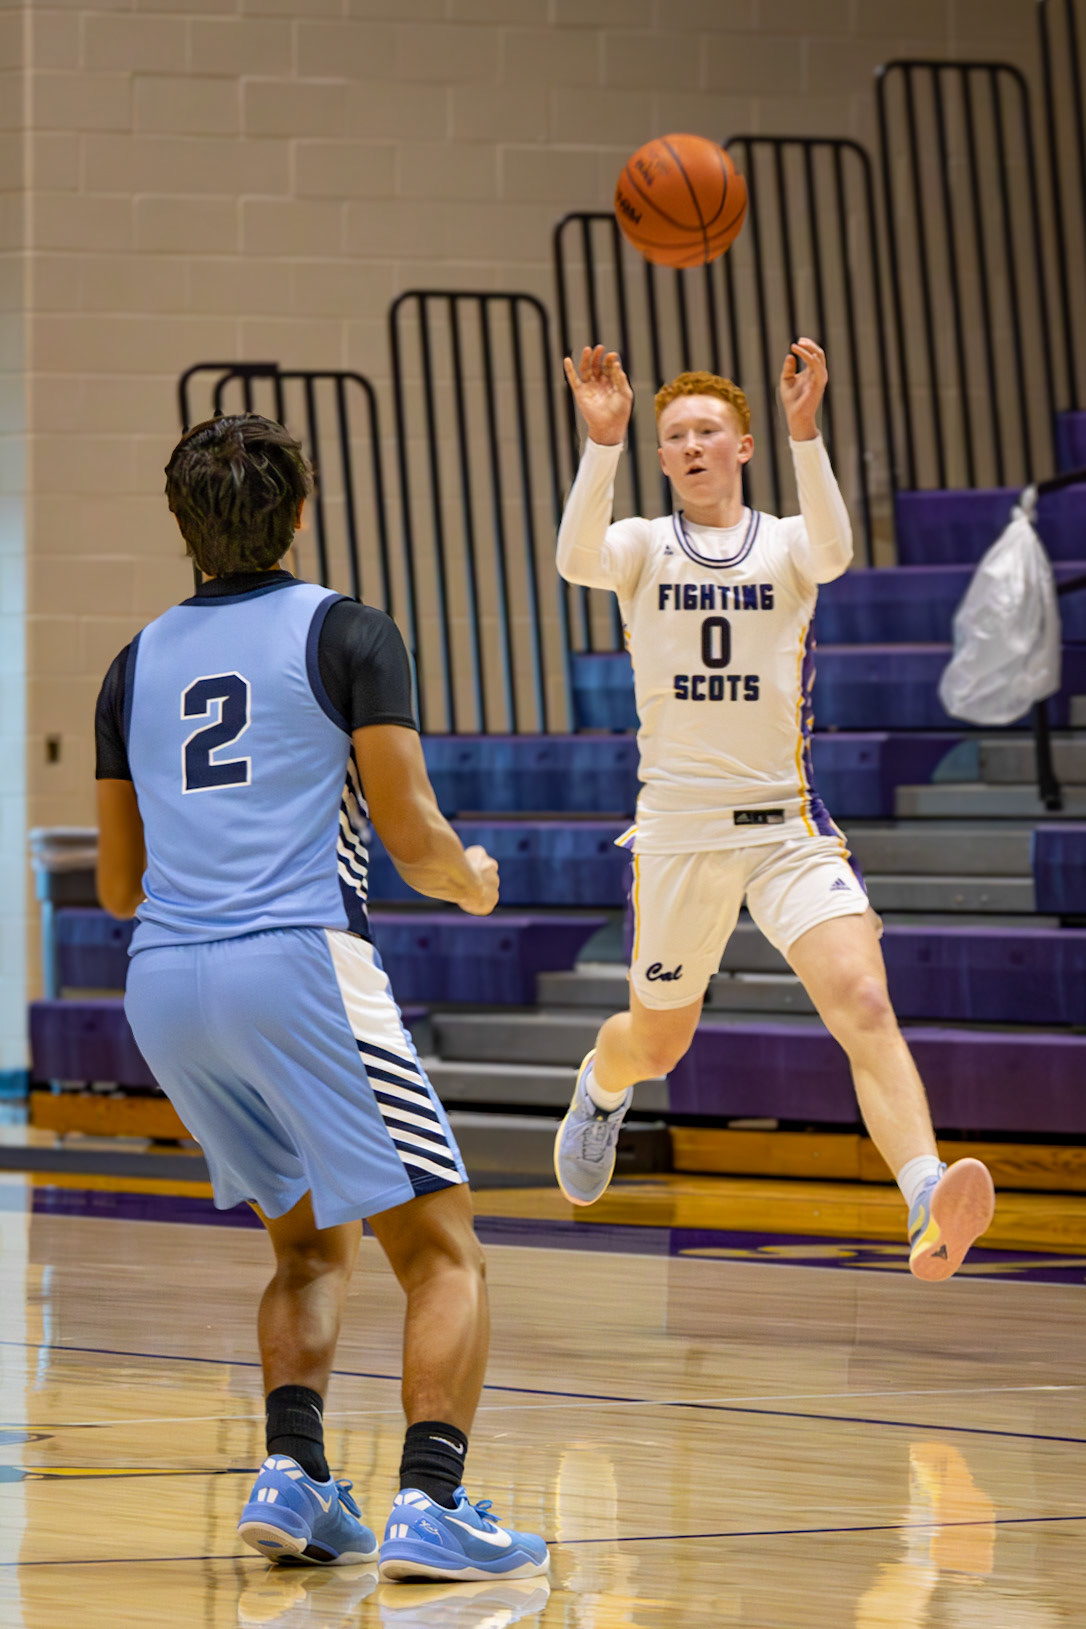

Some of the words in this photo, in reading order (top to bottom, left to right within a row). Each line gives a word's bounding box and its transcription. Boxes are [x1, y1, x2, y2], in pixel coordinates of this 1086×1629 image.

[658, 584, 774, 611] FIGHTING
[701, 616, 731, 669] 0
[673, 675, 760, 702] SCOTS
[180, 670, 253, 795] 2
